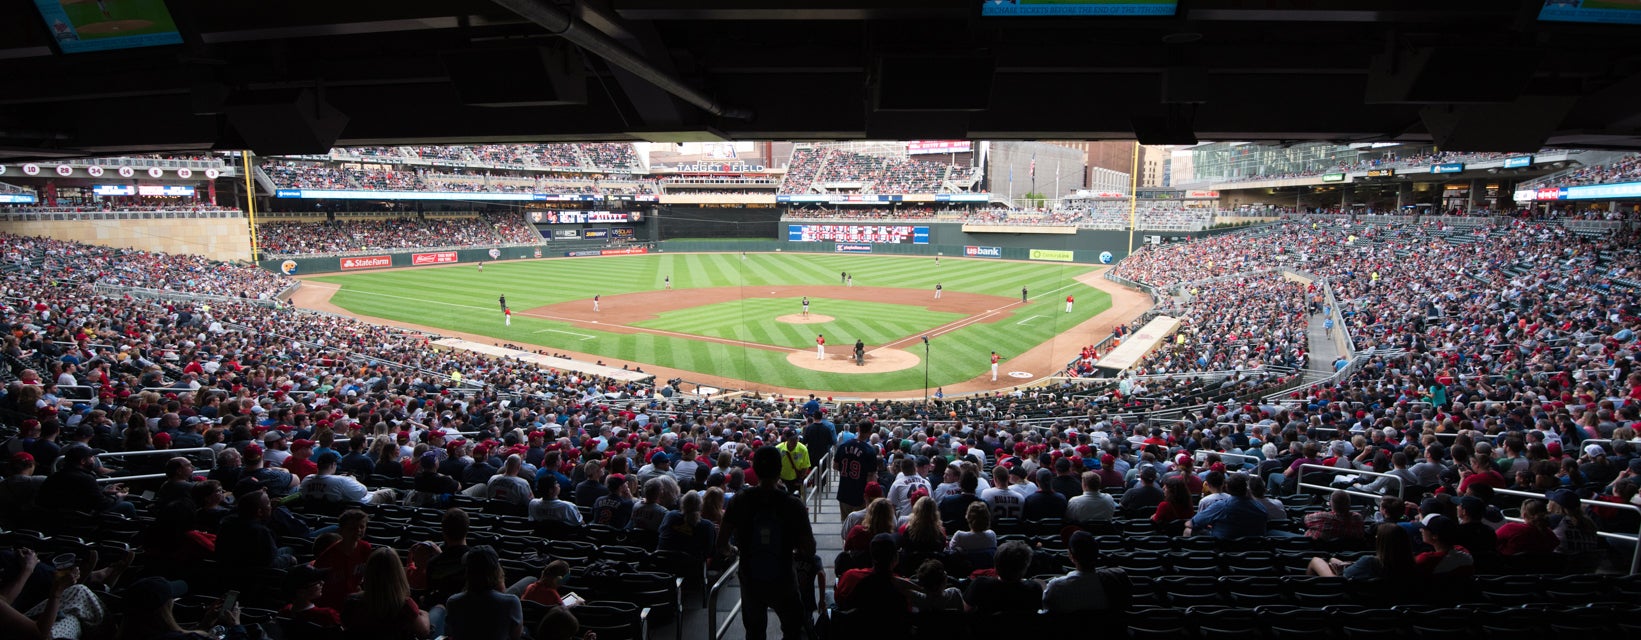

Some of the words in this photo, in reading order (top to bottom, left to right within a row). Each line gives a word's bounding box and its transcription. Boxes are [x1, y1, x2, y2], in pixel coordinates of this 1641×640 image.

[677, 164, 721, 172] TARGET
[732, 164, 764, 172] FIELD
[844, 446, 863, 457] LONG
[840, 458, 862, 480] 19
[993, 505, 1020, 518] 25
